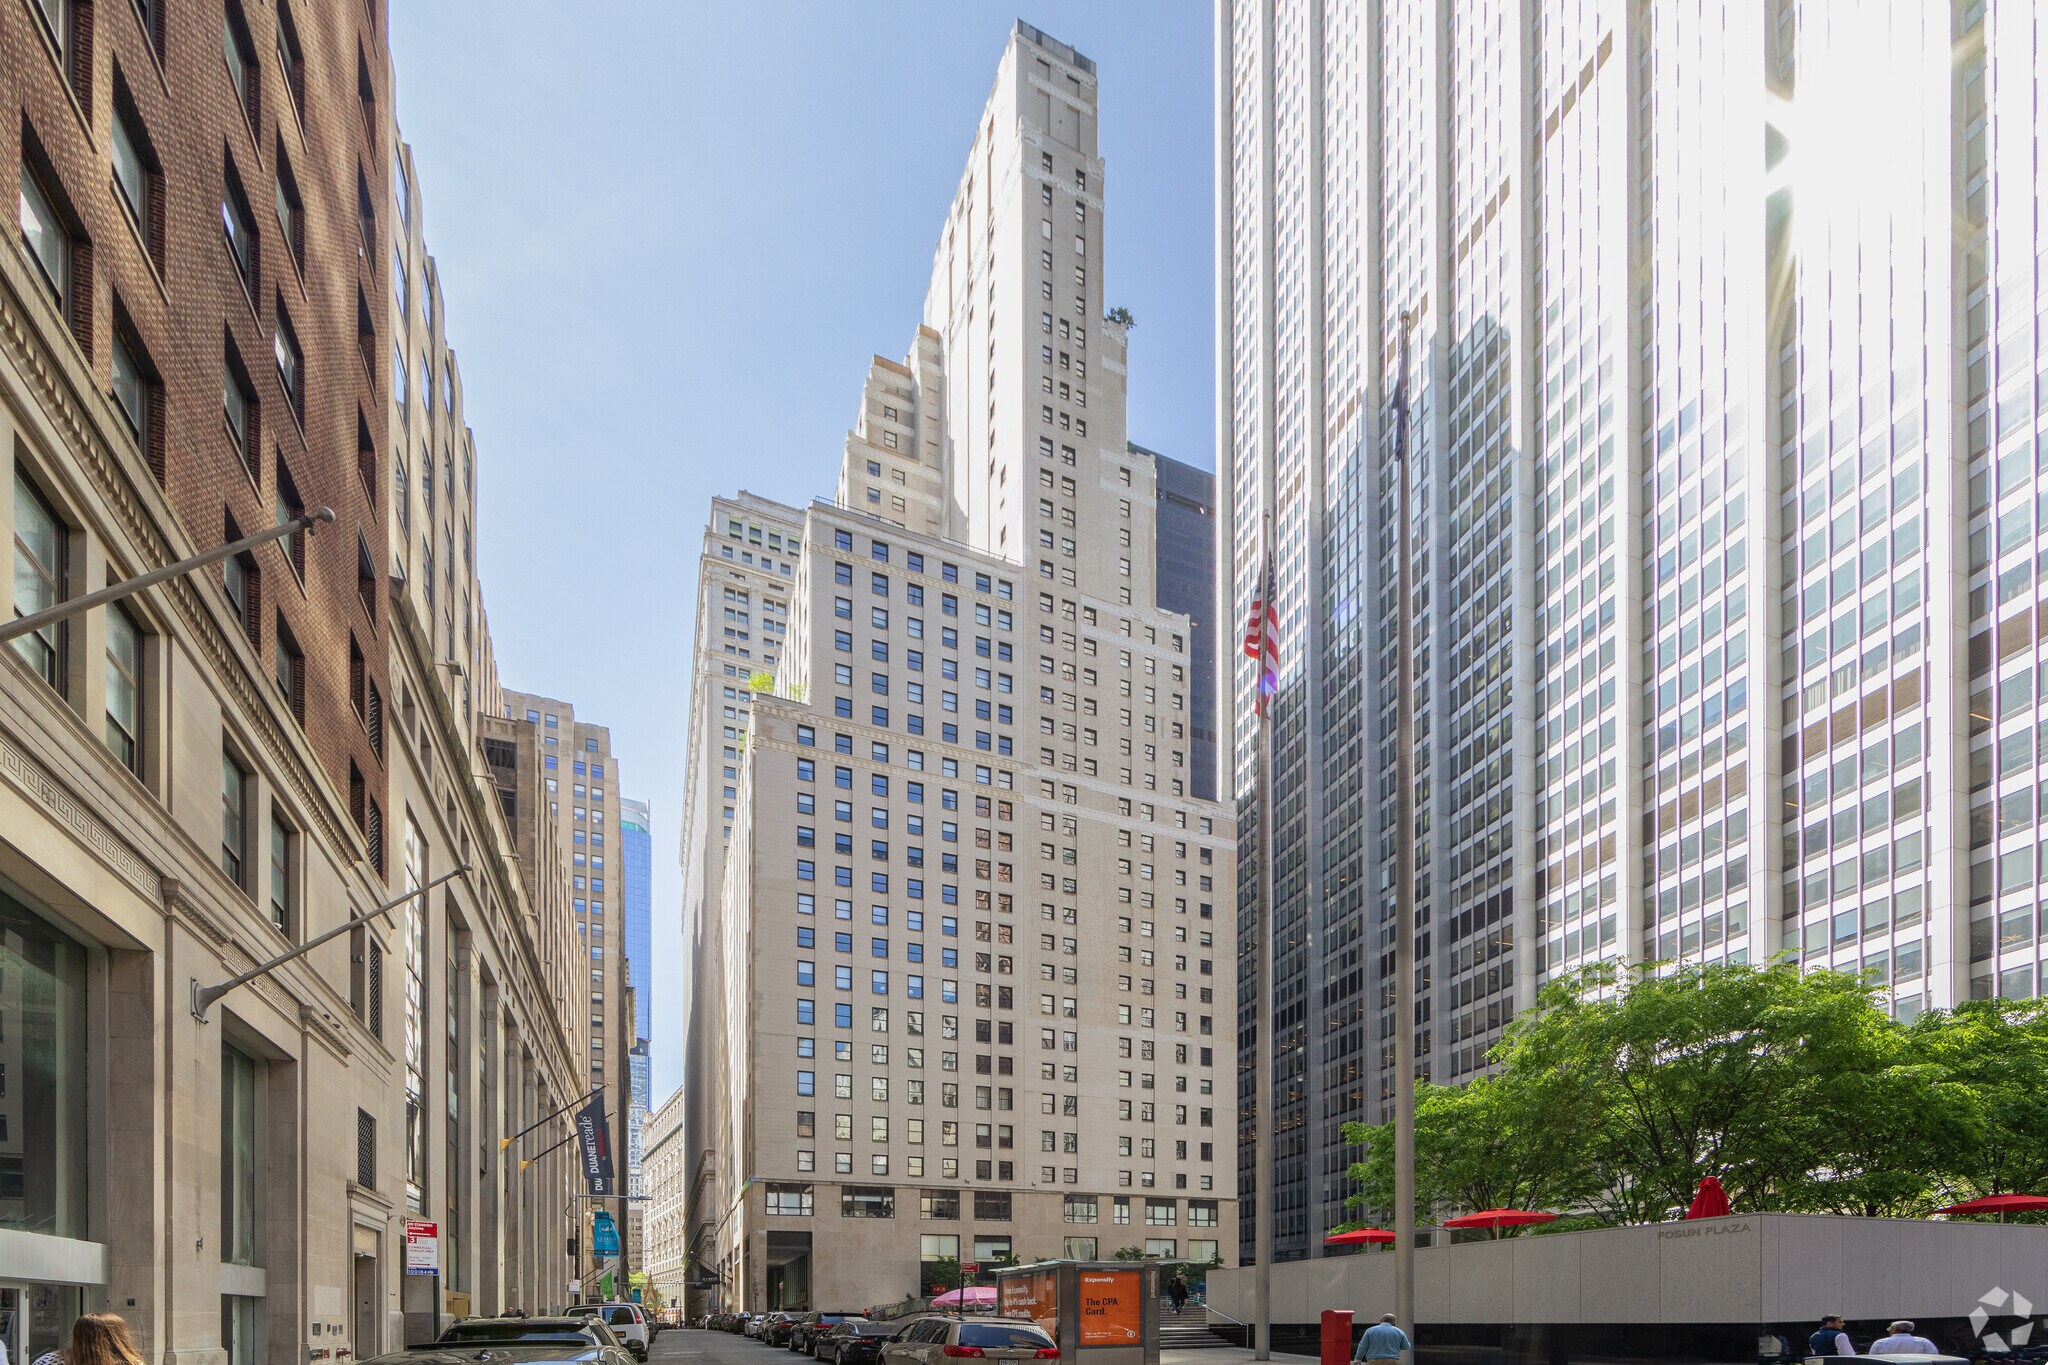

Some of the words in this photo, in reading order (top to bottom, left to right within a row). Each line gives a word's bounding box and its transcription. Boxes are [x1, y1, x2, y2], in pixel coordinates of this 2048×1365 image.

[1657, 1228, 1700, 1240] FOSUN
[1705, 1223, 1751, 1235] PLAZA
[1085, 1298, 1100, 1306] The
[1102, 1298, 1118, 1306] CPA
[1085, 1307, 1107, 1315] Card.
